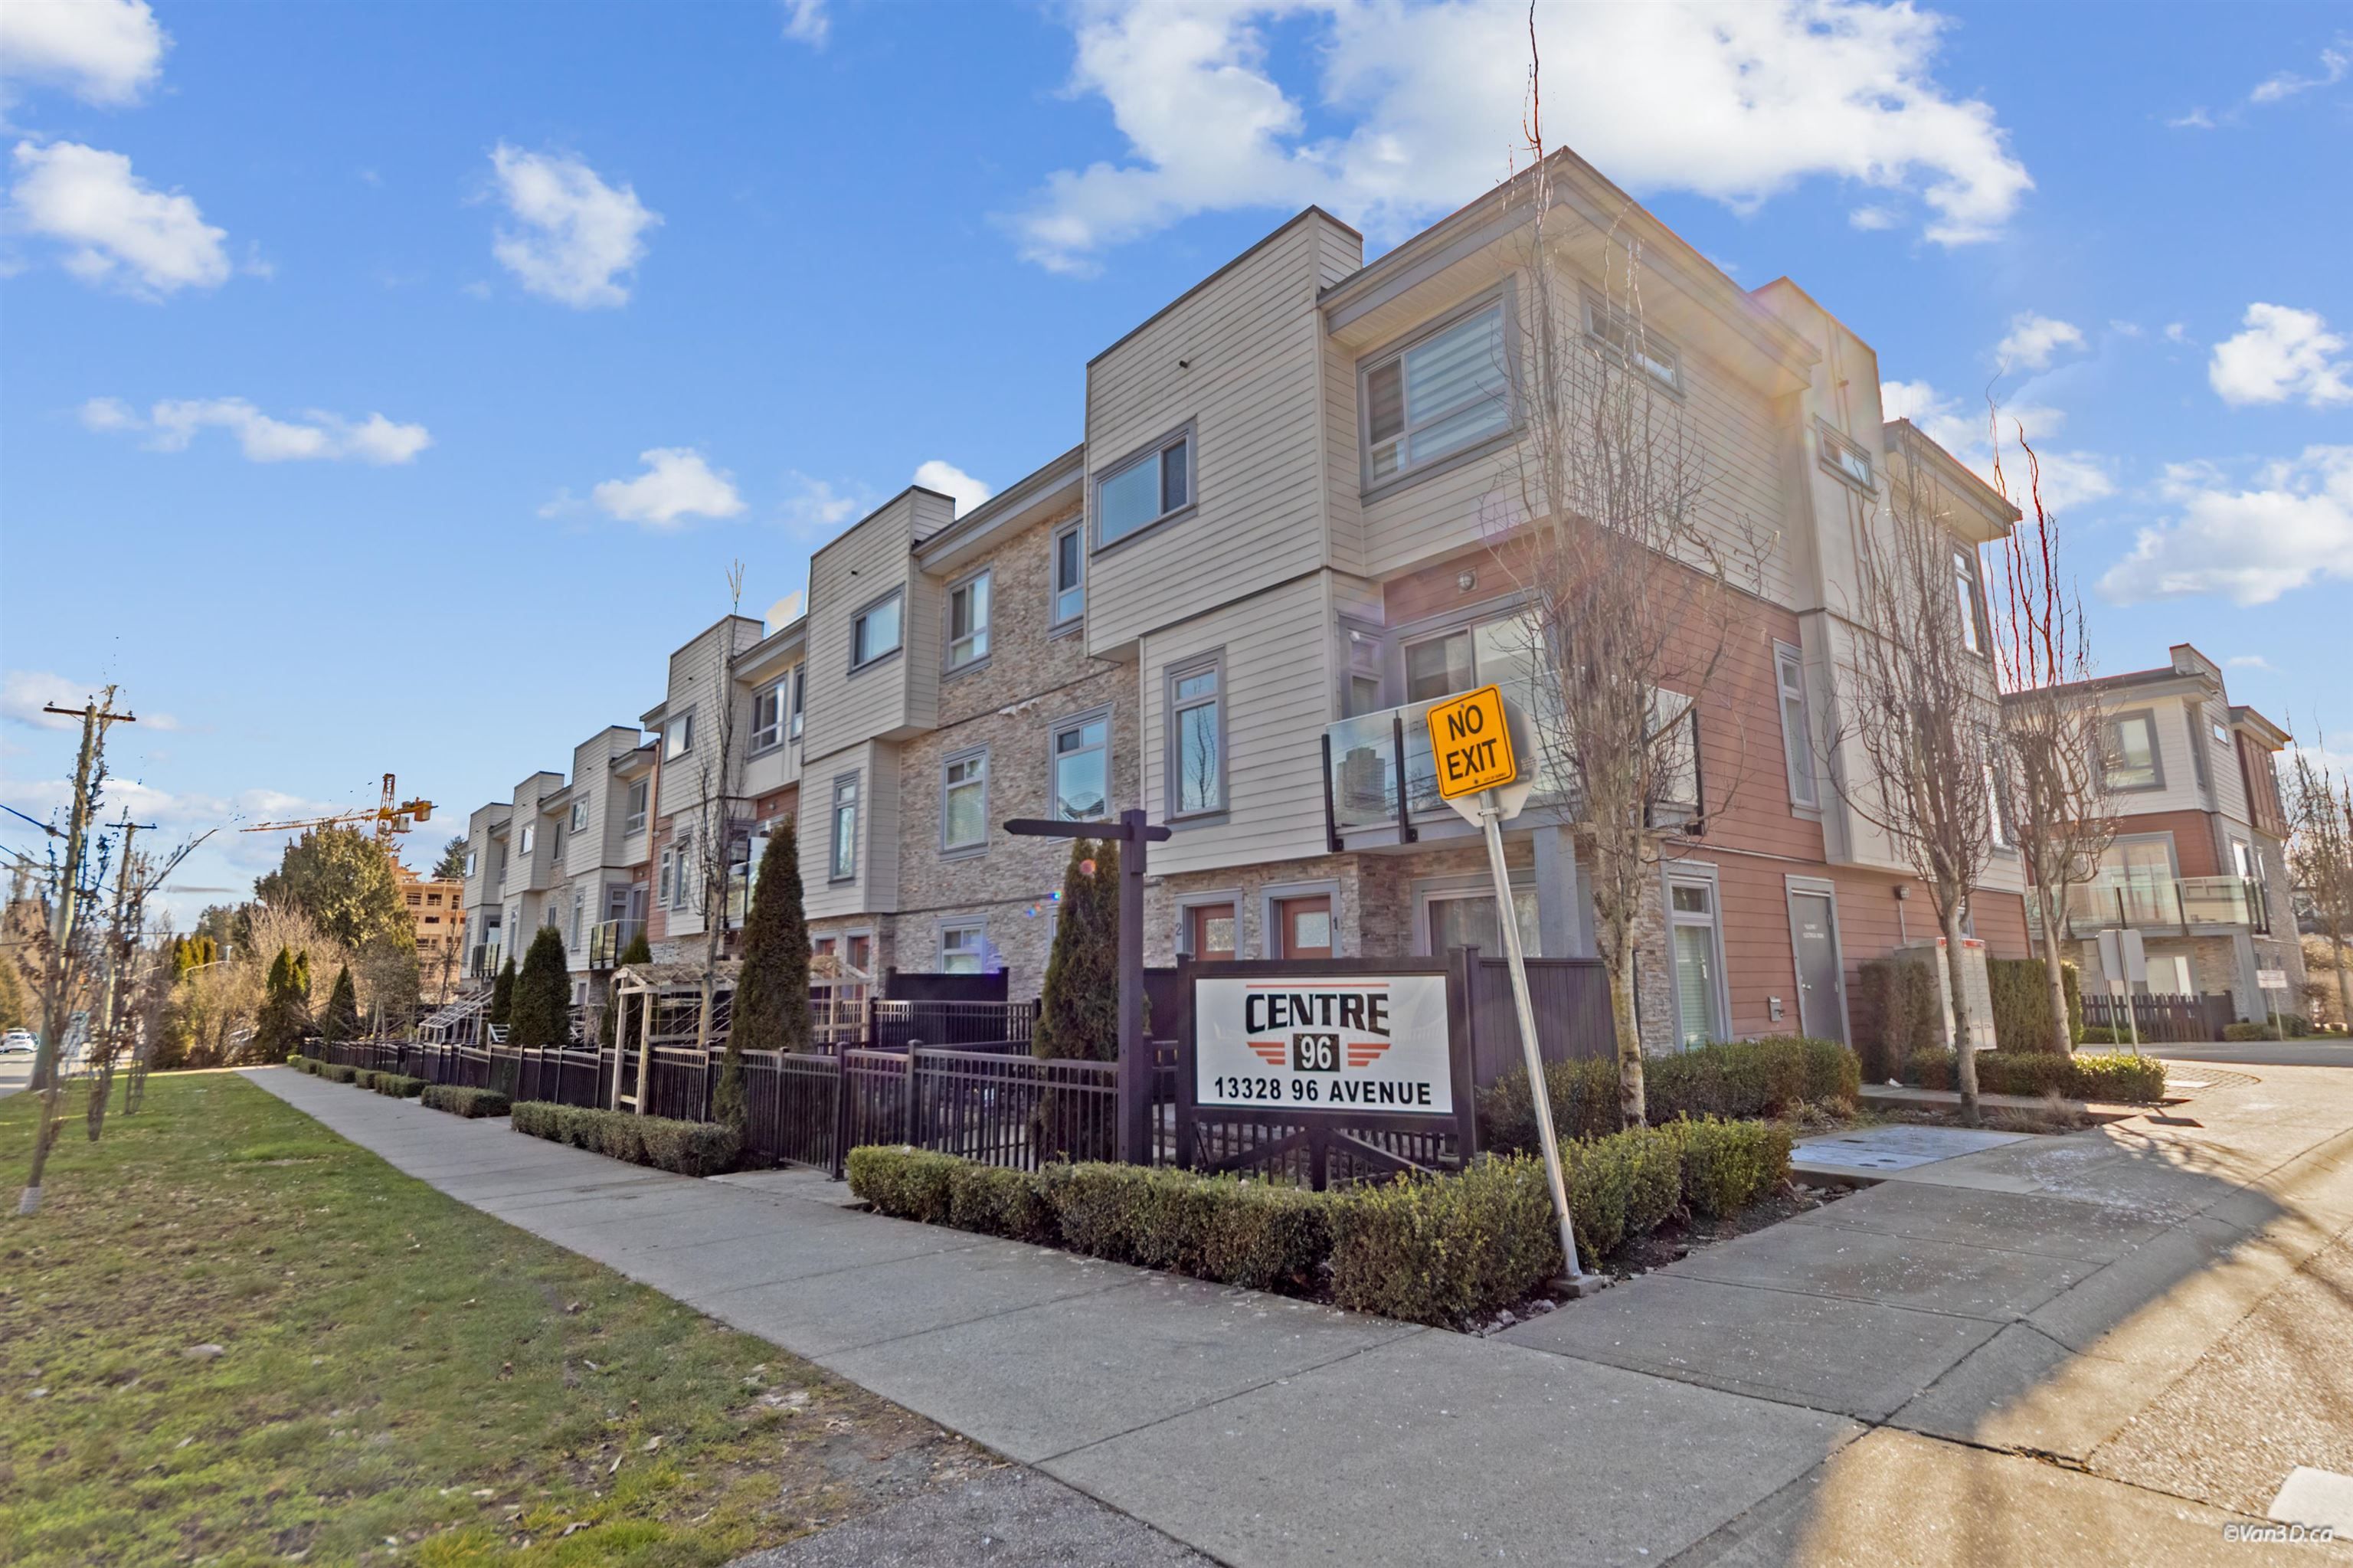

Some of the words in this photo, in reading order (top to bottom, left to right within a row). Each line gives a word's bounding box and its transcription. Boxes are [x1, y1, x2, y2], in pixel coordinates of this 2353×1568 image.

[1447, 704, 1484, 741] NO
[1446, 738, 1497, 781] EXIT
[1176, 922, 1182, 936] 2
[1245, 994, 1390, 1037] CENTRE
[1301, 1035, 1332, 1070] 96
[1215, 1076, 1281, 1100] 13328
[1292, 1079, 1318, 1102] 96
[1329, 1080, 1432, 1105] AVENUE
